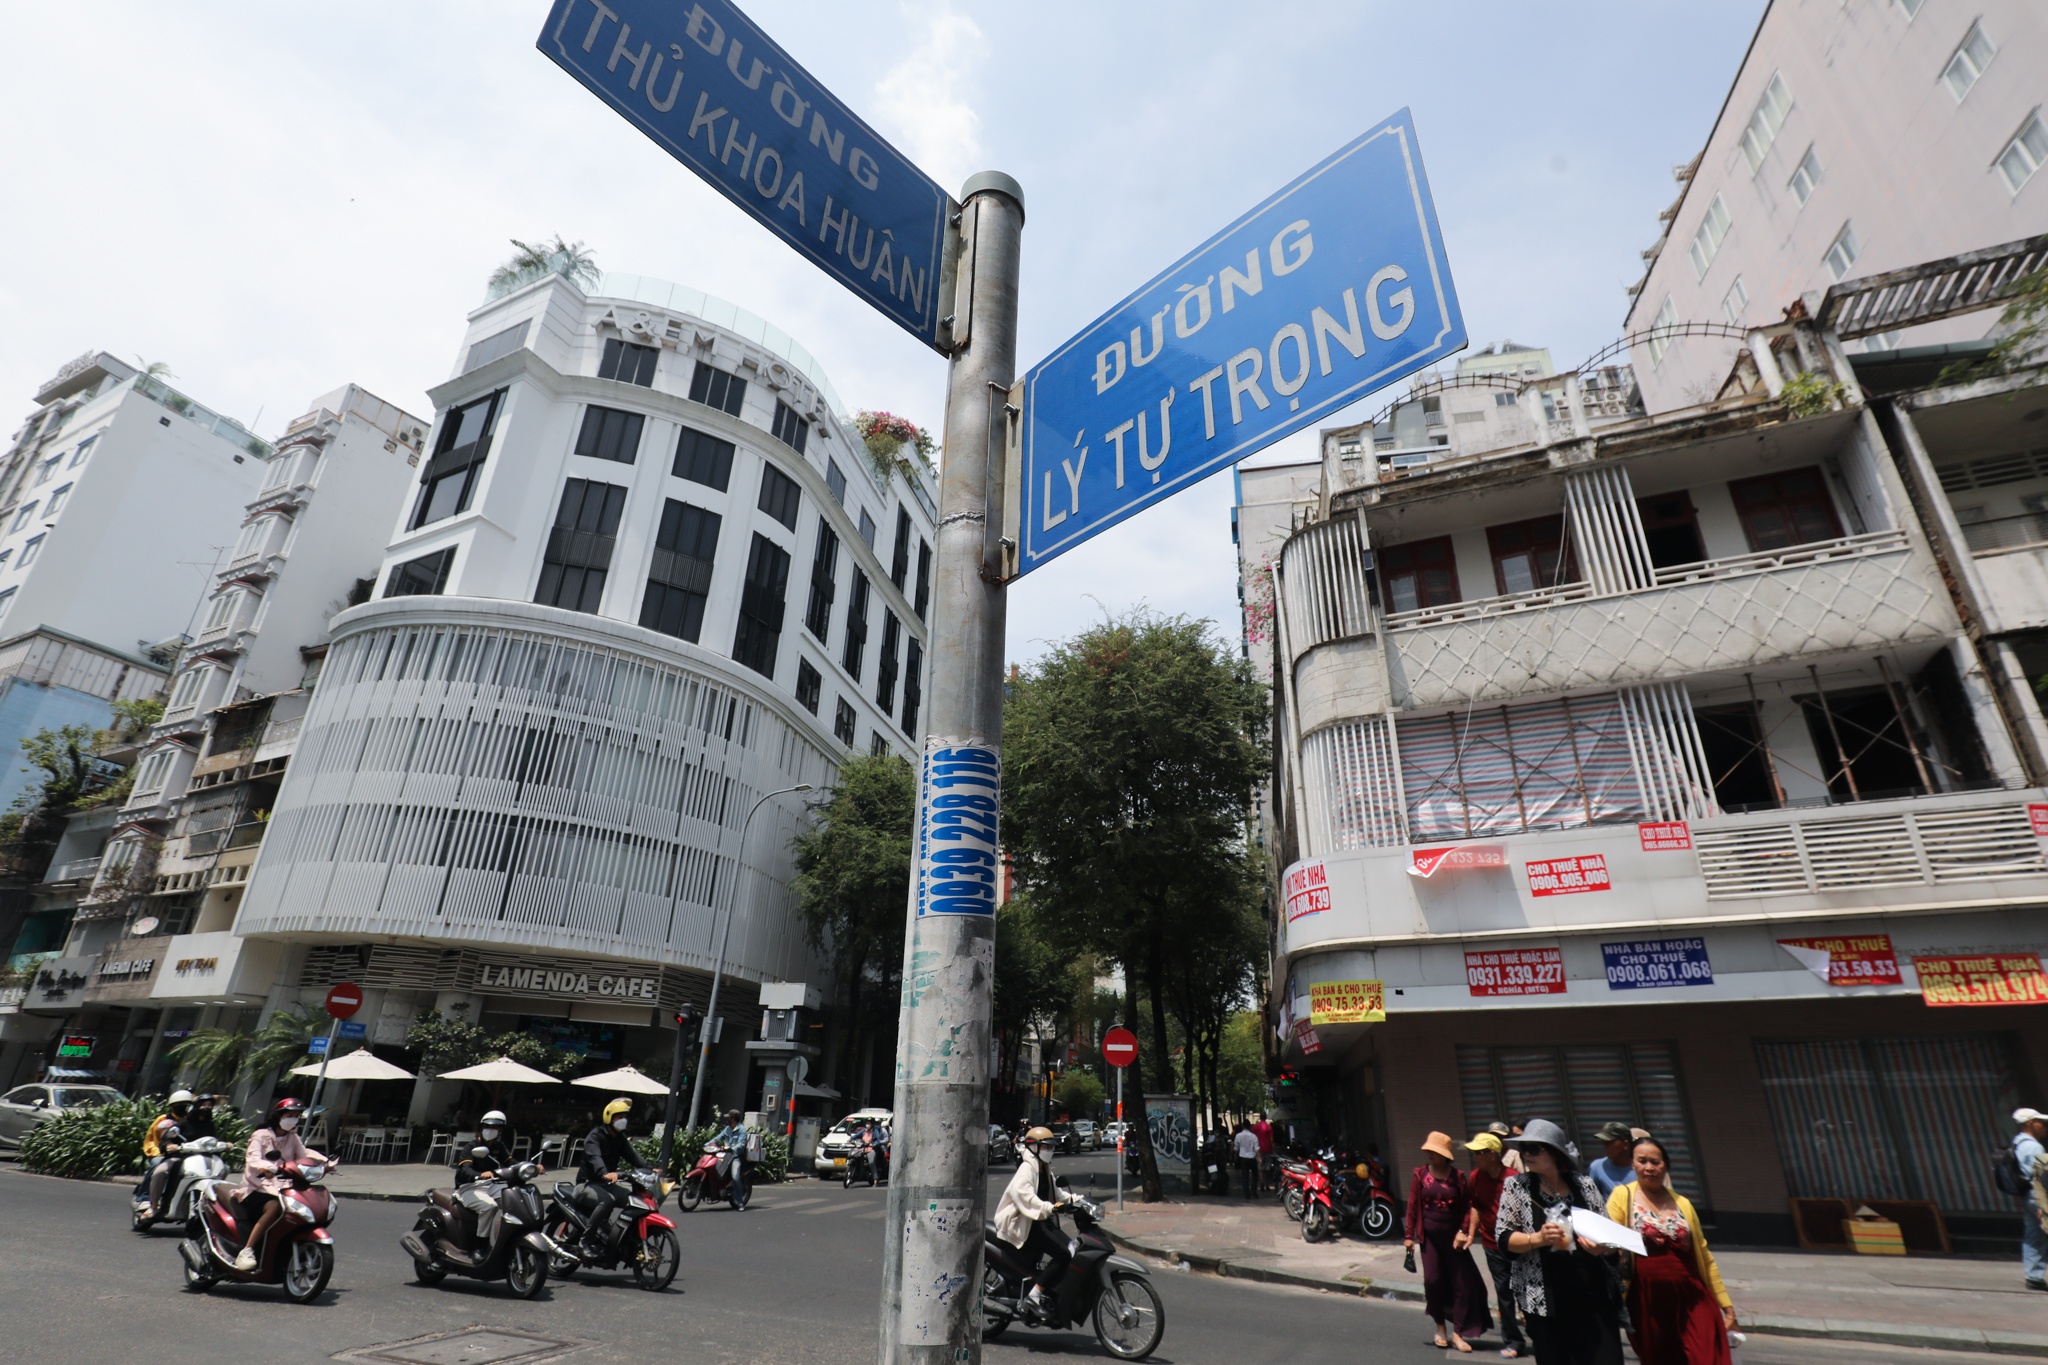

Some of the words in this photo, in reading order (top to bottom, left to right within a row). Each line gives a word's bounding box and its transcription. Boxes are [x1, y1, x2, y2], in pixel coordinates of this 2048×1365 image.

[683, 2, 880, 191] ĐƯỜNG
[580, 0, 684, 113] THỦ
[687, 91, 806, 228] KHOA
[819, 194, 925, 315] HUÂN
[1092, 219, 1314, 395] ĐƯỜNG
[734, 342, 833, 440] HOTEL
[1043, 428, 1089, 533] LÝ
[1105, 386, 1176, 490] TỰ
[1189, 264, 1416, 440] TRỌNG
[929, 748, 998, 915] 0939.228.116
[1307, 860, 1326, 887] NHÀ
[1527, 864, 1549, 876] CHO
[1550, 858, 1579, 874] THUÊ
[1580, 855, 1605, 870] NHÀ
[1530, 870, 1608, 891] 0906.905.006
[1604, 943, 1632, 954] NHÀ
[1635, 941, 1662, 953] BÁN
[1665, 939, 1702, 952] HOẶC
[1814, 939, 1846, 952] CHO
[1848, 935, 1889, 952] THUÊ
[1466, 952, 1483, 966] NHÀ
[1484, 954, 1500, 966] CHO
[1500, 951, 1520, 964] THUÊ
[1521, 950, 1542, 965] HOẶC
[1543, 949, 1560, 962] BÁN
[1620, 954, 1649, 965] CHO
[1651, 952, 1688, 964] THUÊ
[1917, 961, 1952, 974] CHO
[1953, 957, 1999, 972] THUÊ
[1468, 963, 1562, 987] 0931.339.227
[1607, 961, 1712, 983] 0908.061.068
[1829, 960, 1897, 977] 33.58.33
[480, 965, 589, 994] LAMENDA
[597, 975, 655, 999] CAFE
[1323, 983, 1336, 996] BÁN
[1337, 984, 1343, 995] &
[1344, 984, 1360, 994] CHO
[1362, 981, 1382, 994] THUÊ
[1312, 995, 1383, 1013] 0909.75.33.53
